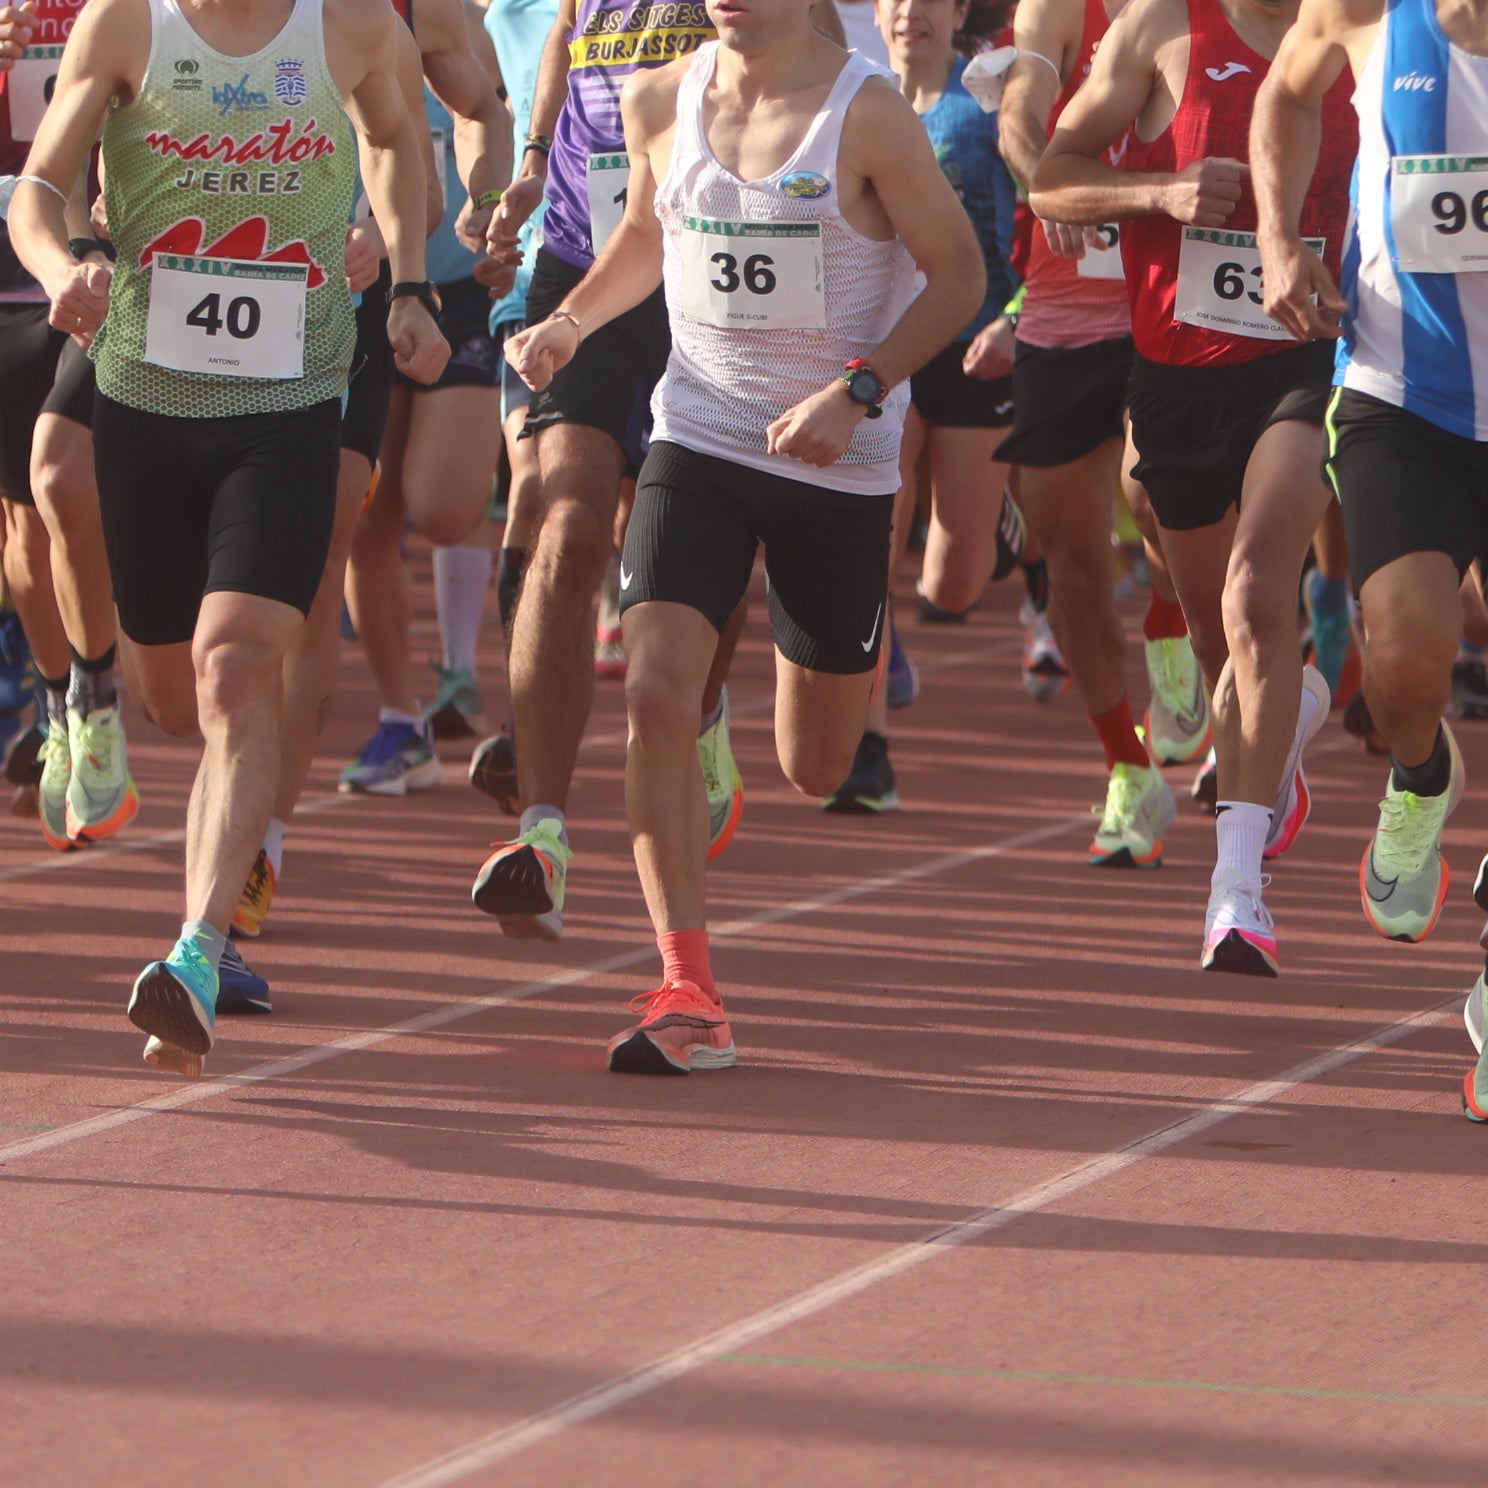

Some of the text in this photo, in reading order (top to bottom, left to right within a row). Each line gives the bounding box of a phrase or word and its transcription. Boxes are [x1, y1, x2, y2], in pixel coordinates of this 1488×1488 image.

[583, 2, 707, 35] ELS SITGES
[585, 33, 708, 61] BURJASSOT
[145, 116, 336, 165] maratón
[176, 169, 302, 194] JEREZ
[683, 216, 742, 236] XXXIV
[1185, 228, 1256, 248] XXXIV
[158, 254, 232, 275] XXXIV
[266, 272, 277, 280] DE
[710, 252, 777, 295] 36
[185, 292, 261, 340] 40
[1210, 315, 1241, 326] DOMINGO
[1242, 320, 1269, 330] ROMERO
[208, 357, 240, 366] ANTONIO
